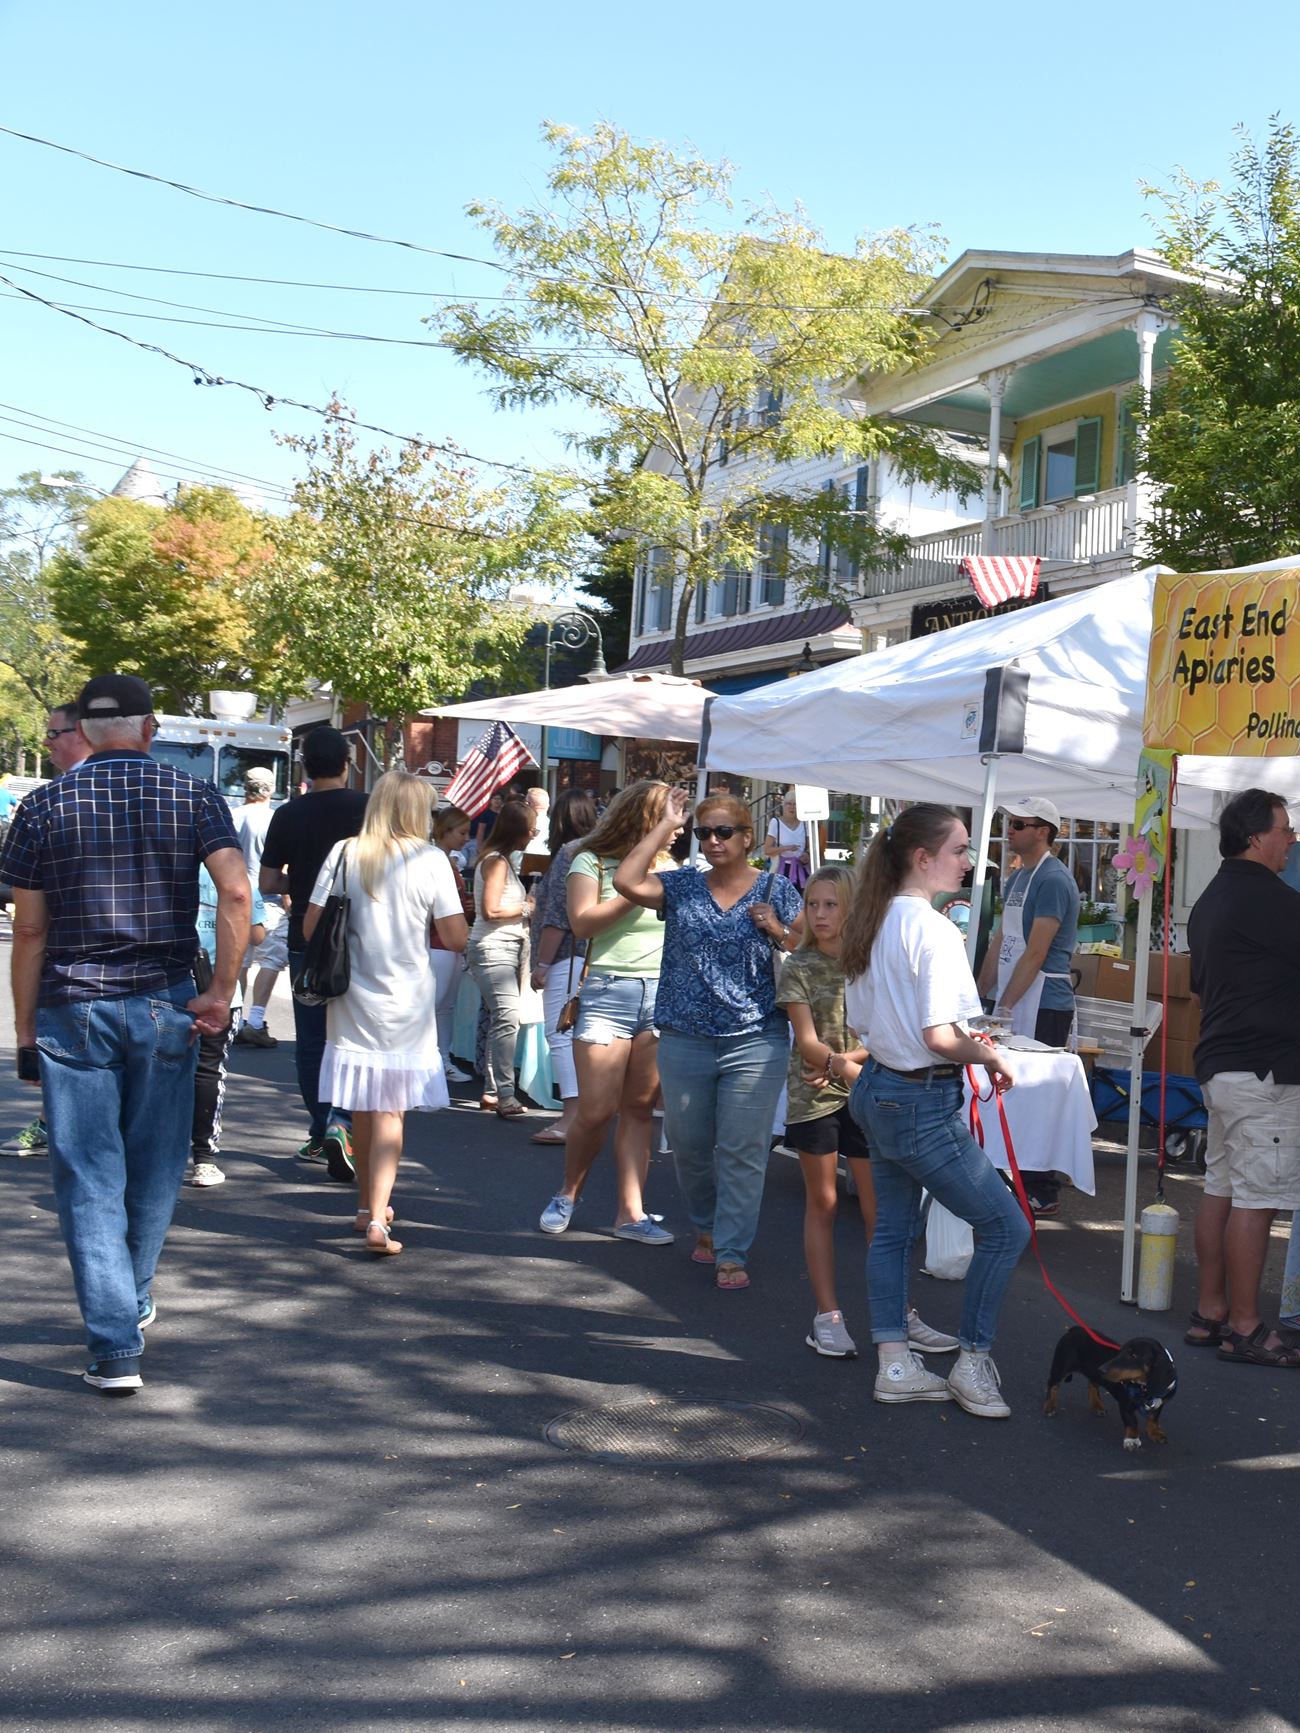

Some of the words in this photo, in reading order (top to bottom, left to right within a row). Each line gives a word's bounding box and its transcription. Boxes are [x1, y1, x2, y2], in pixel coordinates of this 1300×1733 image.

[925, 600, 1034, 633] ANTIQUE
[1179, 604, 1234, 640] East
[1241, 598, 1287, 636] End
[1172, 647, 1275, 696] Apiaries
